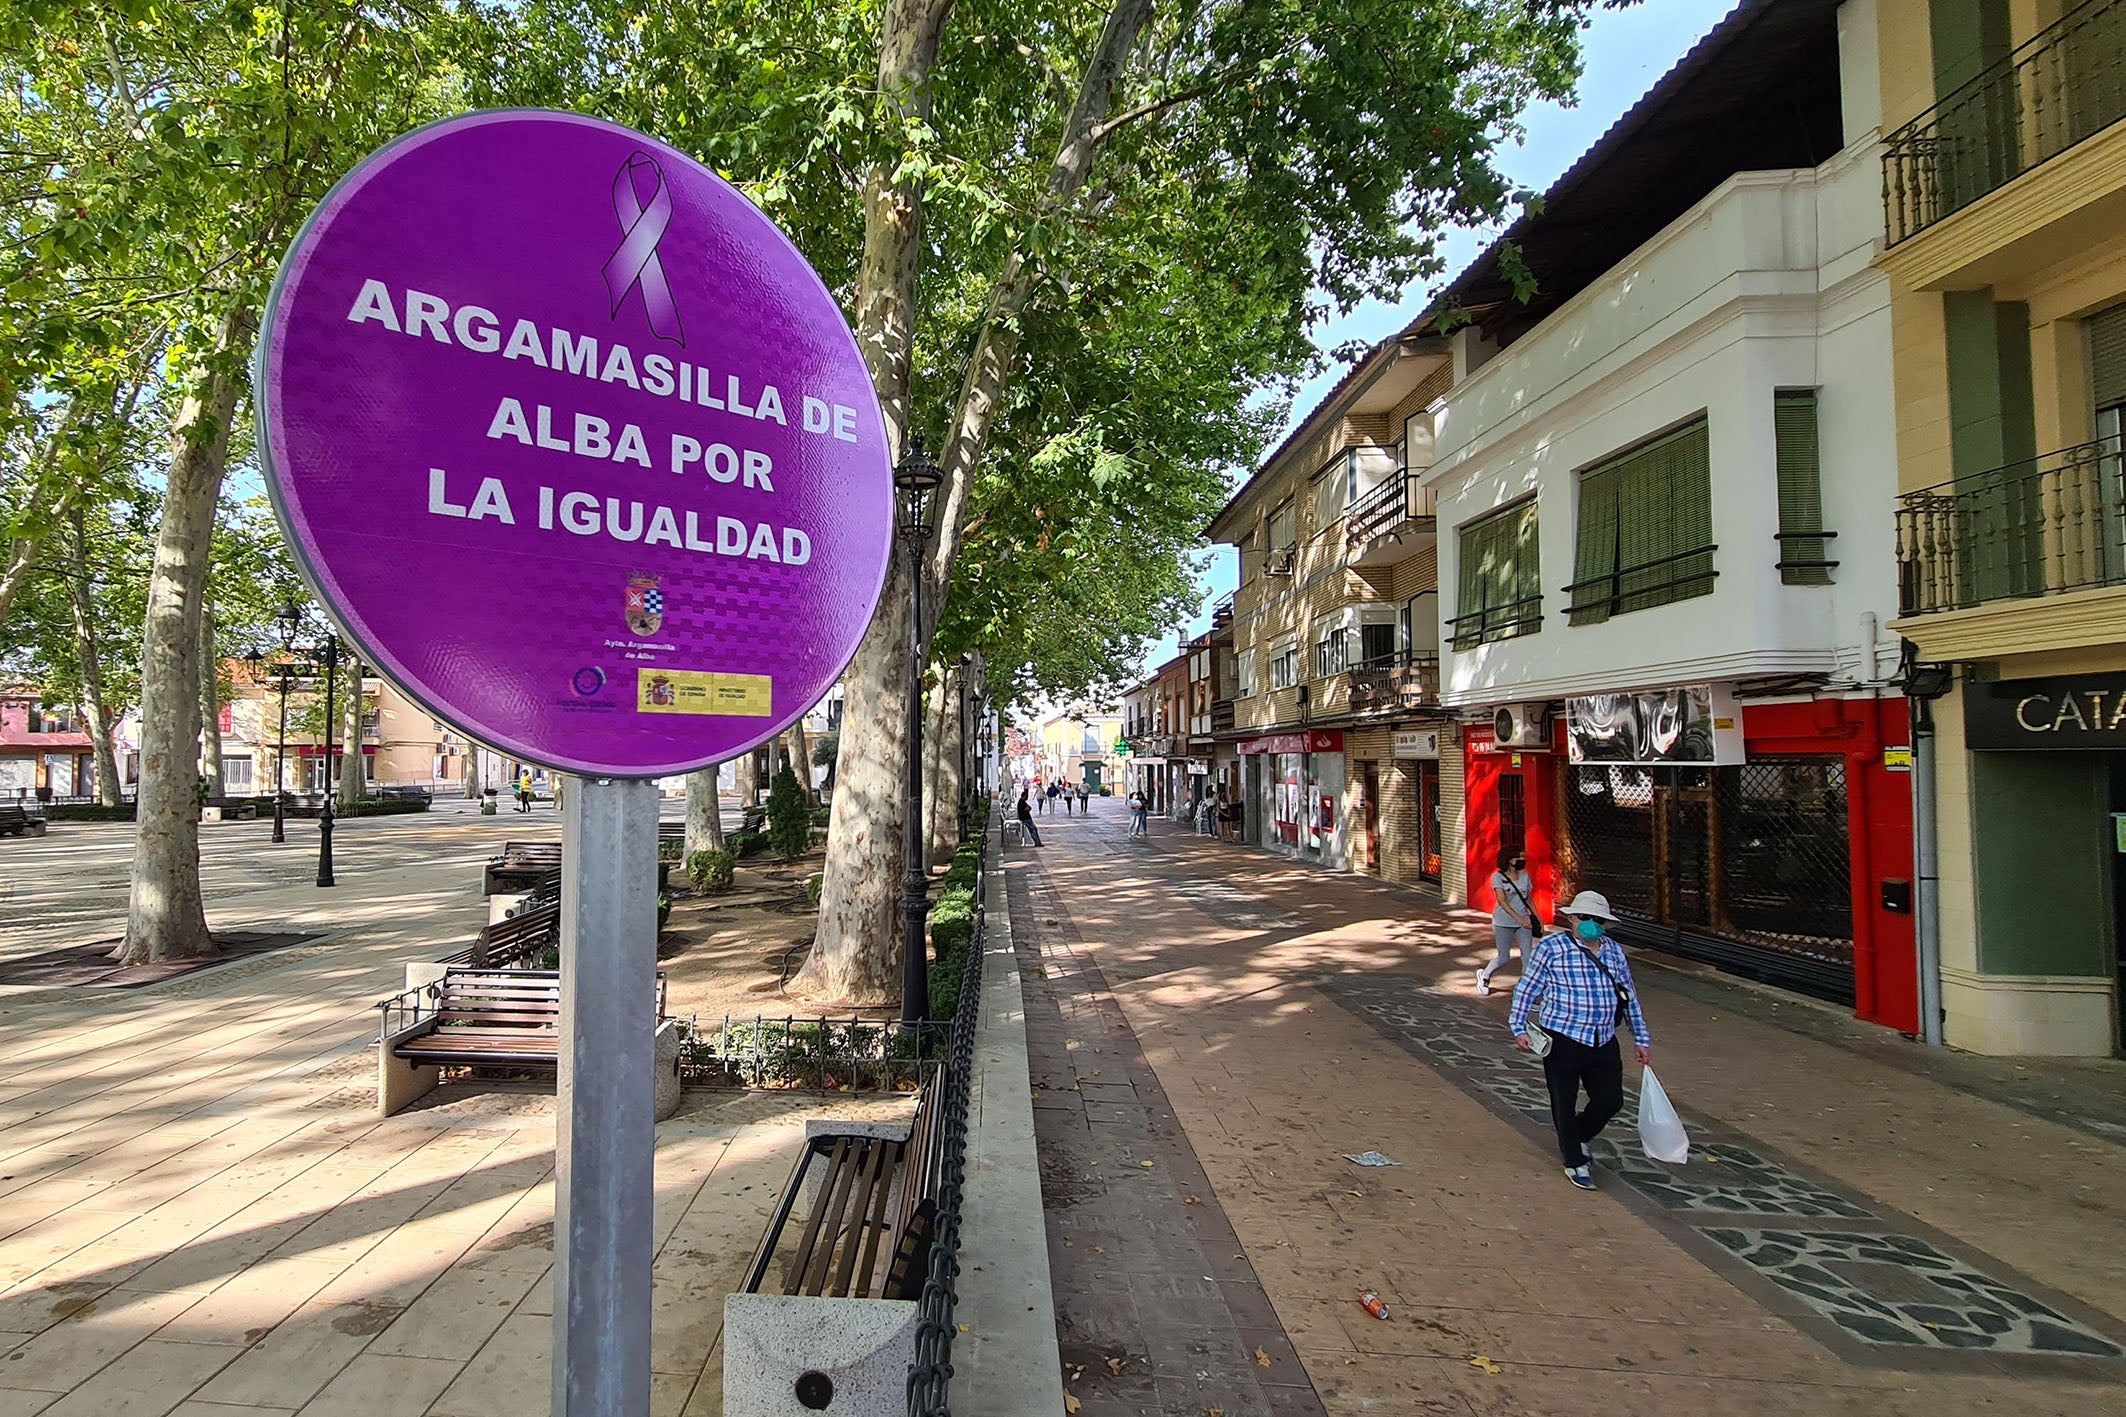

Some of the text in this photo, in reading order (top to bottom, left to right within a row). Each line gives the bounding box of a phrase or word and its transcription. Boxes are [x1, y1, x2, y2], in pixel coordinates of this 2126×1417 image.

[348, 278, 858, 443] ARGAMASILLA DE
[487, 397, 774, 492] ALBA POR
[428, 469, 812, 566] LA IGUALDAD
